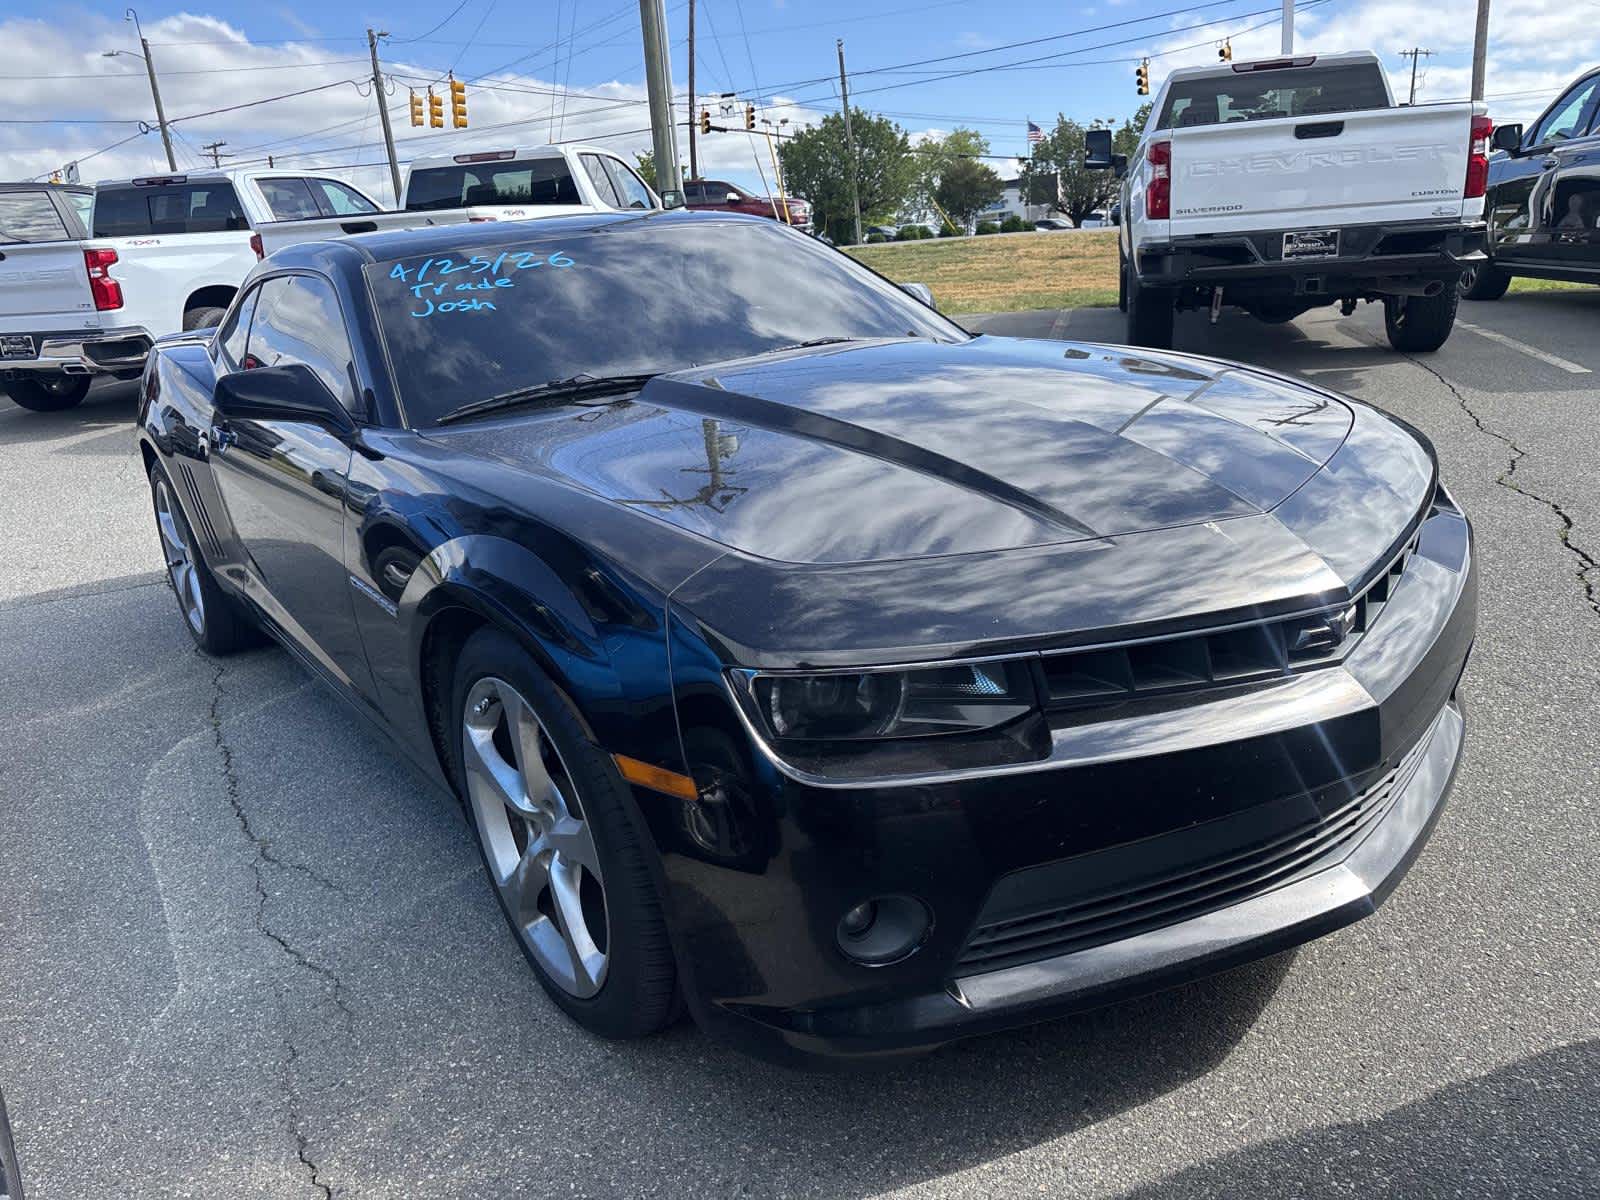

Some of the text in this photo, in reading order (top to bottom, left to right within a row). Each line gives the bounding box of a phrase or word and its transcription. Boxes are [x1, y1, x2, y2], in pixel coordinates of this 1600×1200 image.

[1190, 143, 1448, 177] CHEVROLET
[1176, 204, 1244, 215] SILVERADO
[389, 251, 575, 282] 4/25/26
[410, 278, 515, 299] Trade
[412, 300, 497, 318] Josh
